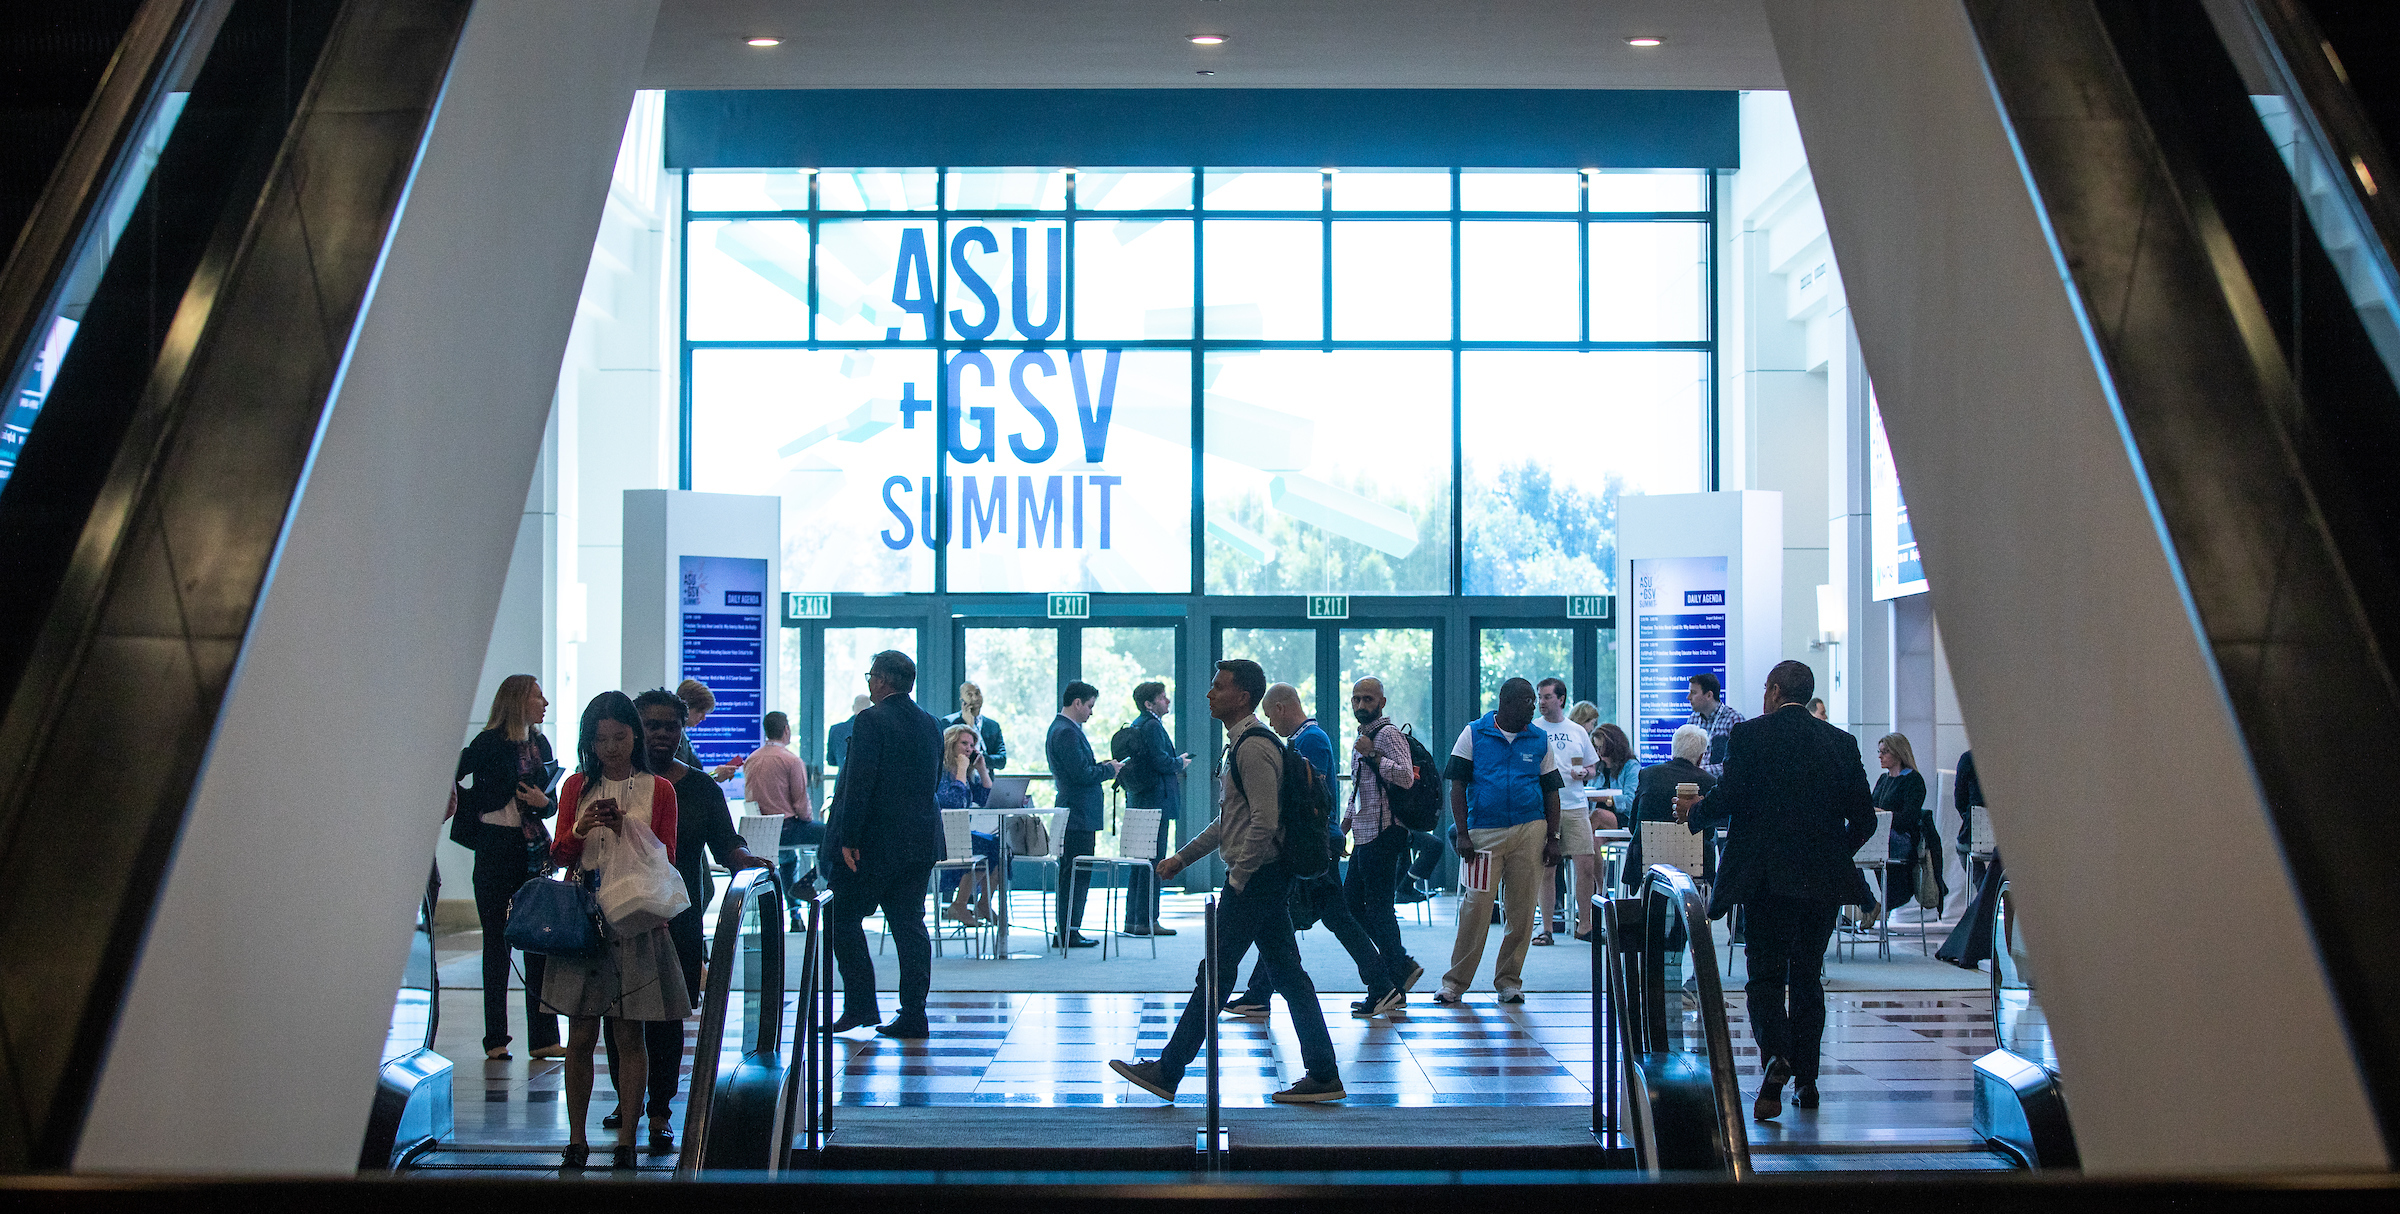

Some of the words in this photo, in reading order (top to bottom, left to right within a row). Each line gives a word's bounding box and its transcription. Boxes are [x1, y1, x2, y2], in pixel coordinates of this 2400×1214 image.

[886, 226, 1062, 341] ASU
[880, 475, 1122, 550] SUMMIT
[1640, 576, 1653, 588] ASU
[797, 596, 825, 615] EXIT
[1056, 596, 1083, 615] EXIT
[1315, 597, 1342, 616] EXIT
[1575, 597, 1602, 616] EXIT
[1687, 594, 1702, 604] DAILY
[1702, 593, 1723, 604] AGENDA
